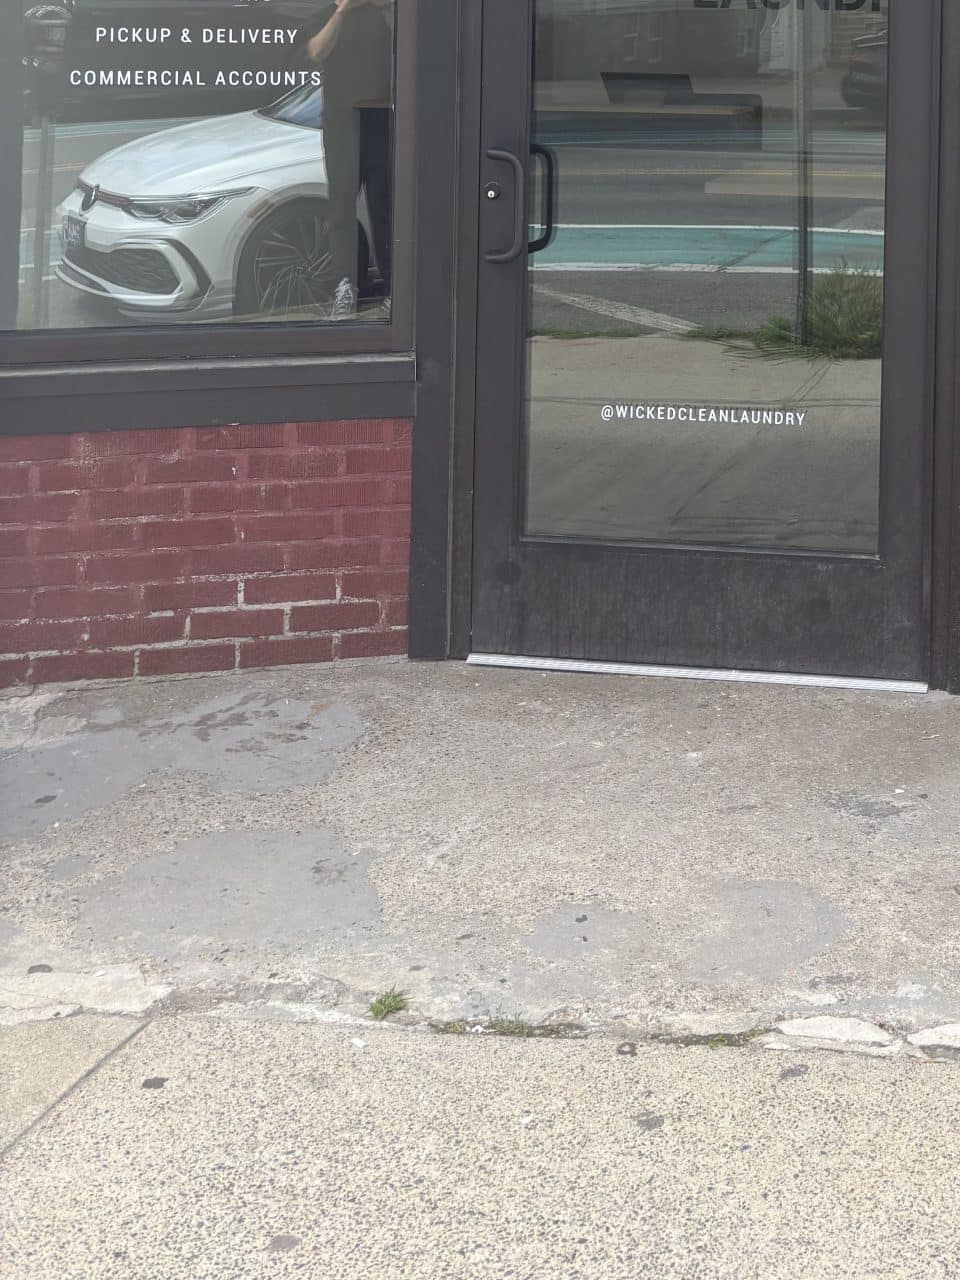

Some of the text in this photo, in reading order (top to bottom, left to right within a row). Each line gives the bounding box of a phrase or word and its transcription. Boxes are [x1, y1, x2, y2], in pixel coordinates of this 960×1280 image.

[95, 28, 298, 44] PICKUP & DELIVERY
[70, 71, 321, 86] COMMERCIAL ACCOUNTS
[600, 405, 805, 426] @WICKEDCLEANLAUNDRY
